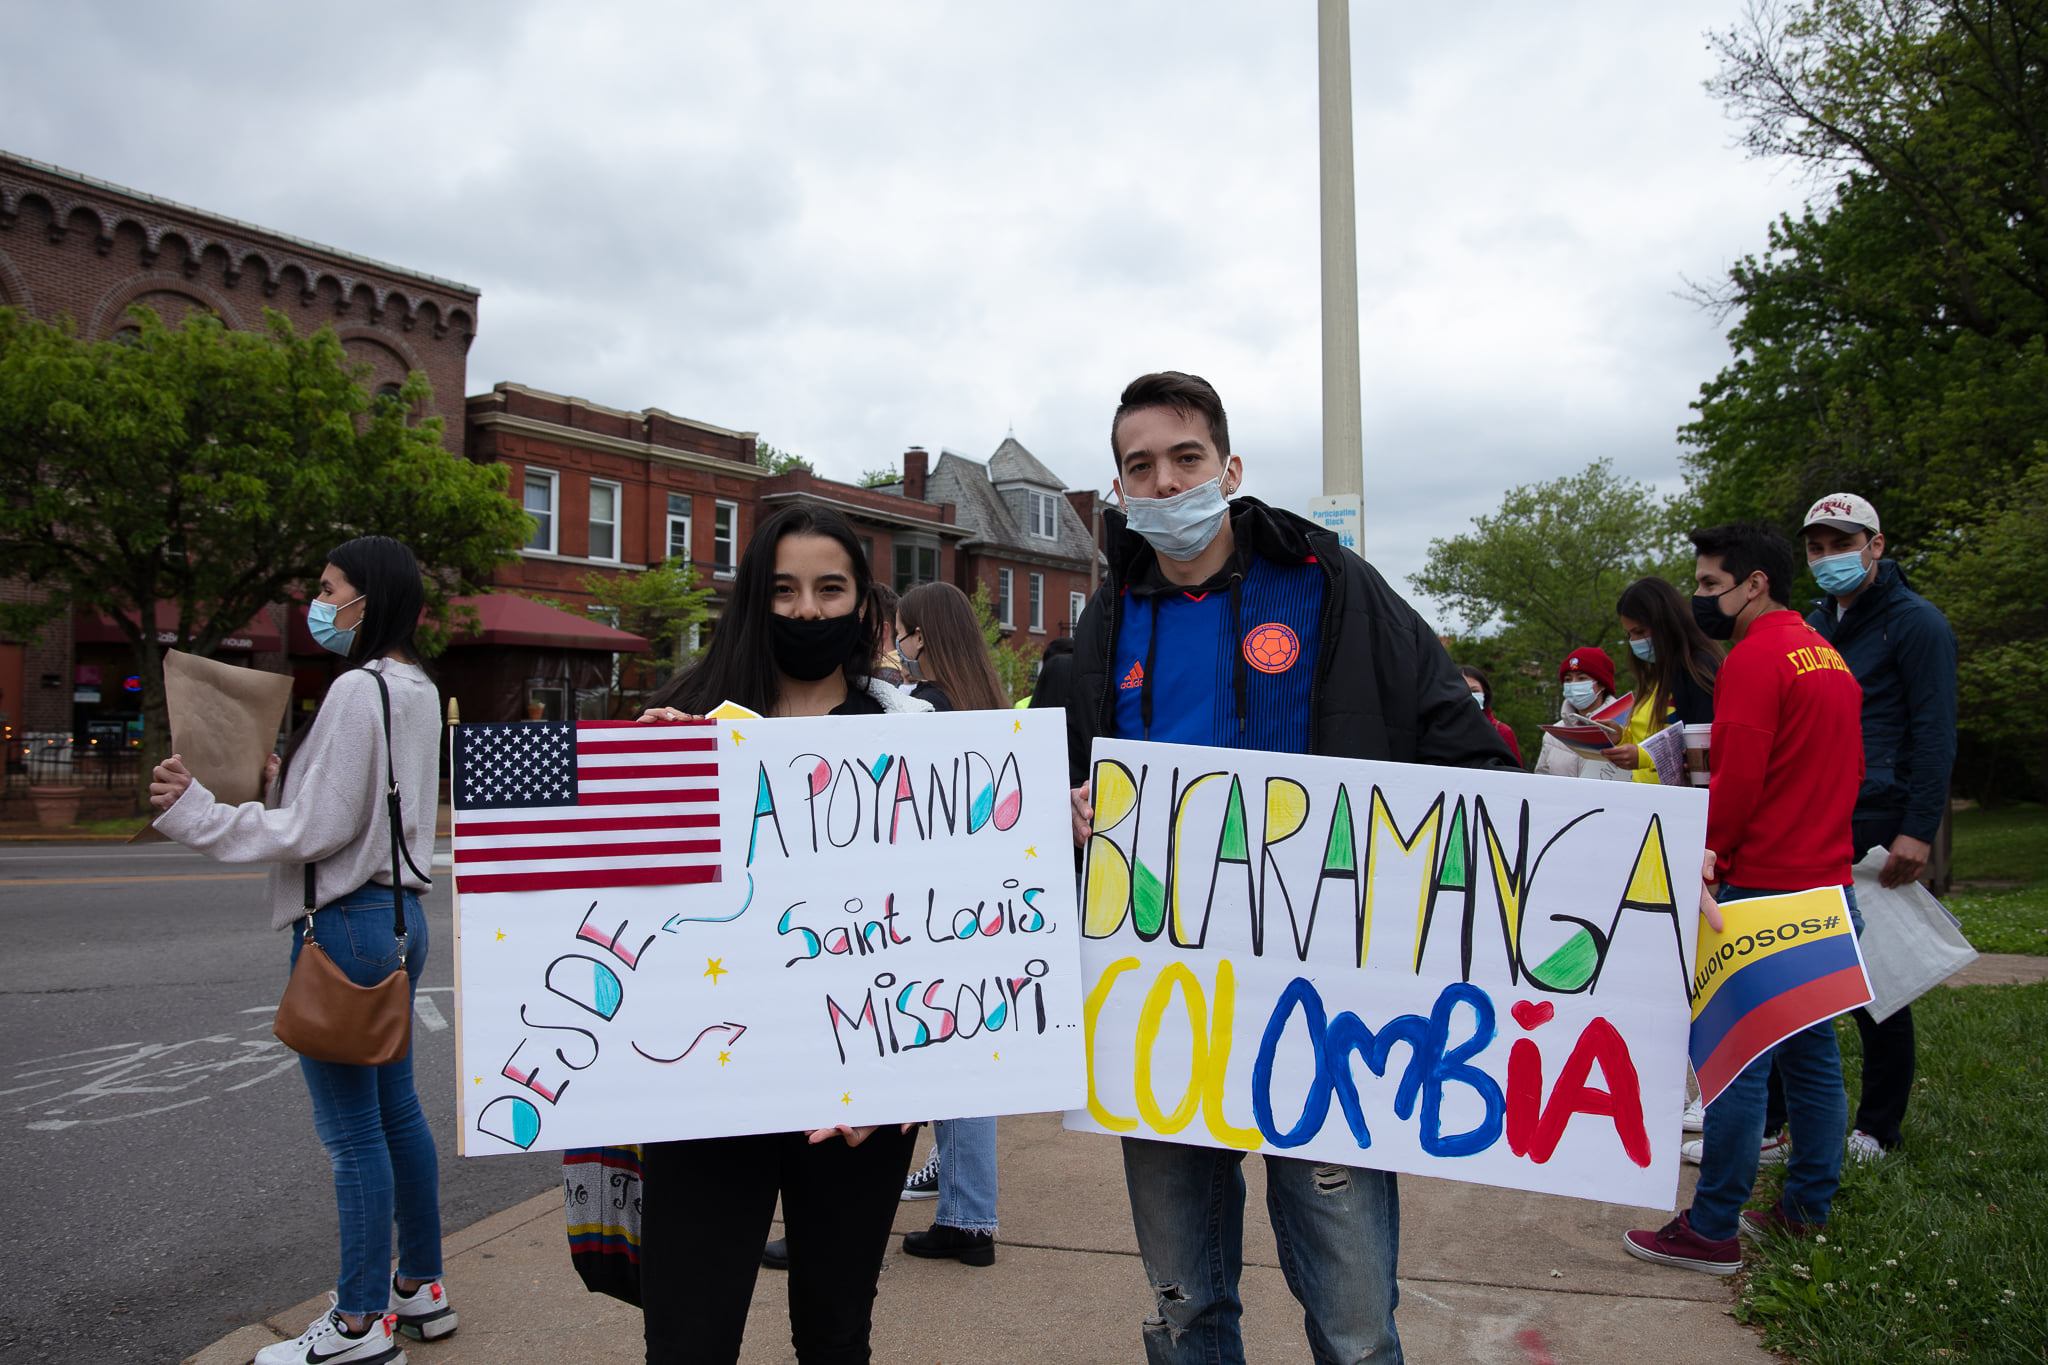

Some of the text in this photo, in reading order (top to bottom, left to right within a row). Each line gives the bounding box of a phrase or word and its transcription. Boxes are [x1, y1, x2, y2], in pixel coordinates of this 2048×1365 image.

[1312, 508, 1356, 519] Participating
[1325, 518, 1344, 526] Block
[1081, 758, 1693, 1009] BUCARAMANGA
[777, 894, 912, 967] Saint
